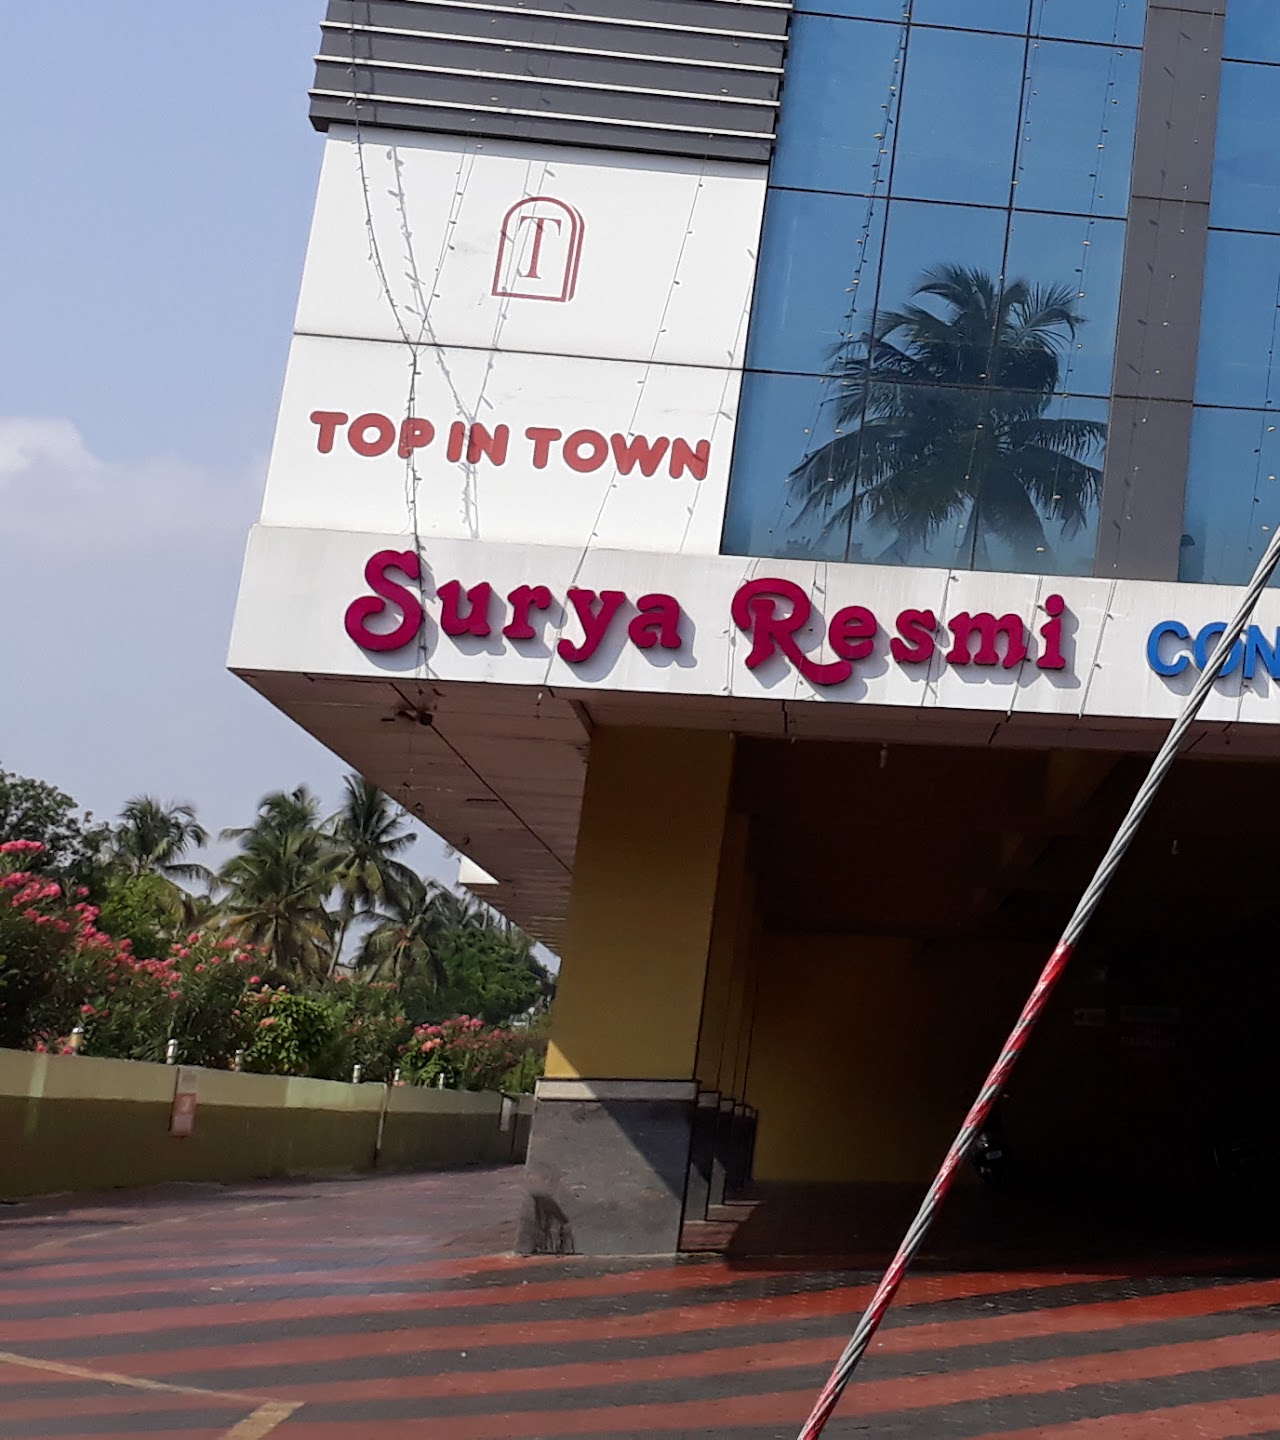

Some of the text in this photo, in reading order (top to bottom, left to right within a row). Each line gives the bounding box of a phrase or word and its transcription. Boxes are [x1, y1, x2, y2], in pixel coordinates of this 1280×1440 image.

[518, 216, 561, 279] T
[310, 411, 711, 481] TOP IN TOWN
[344, 549, 1065, 685] Surya Resmi
